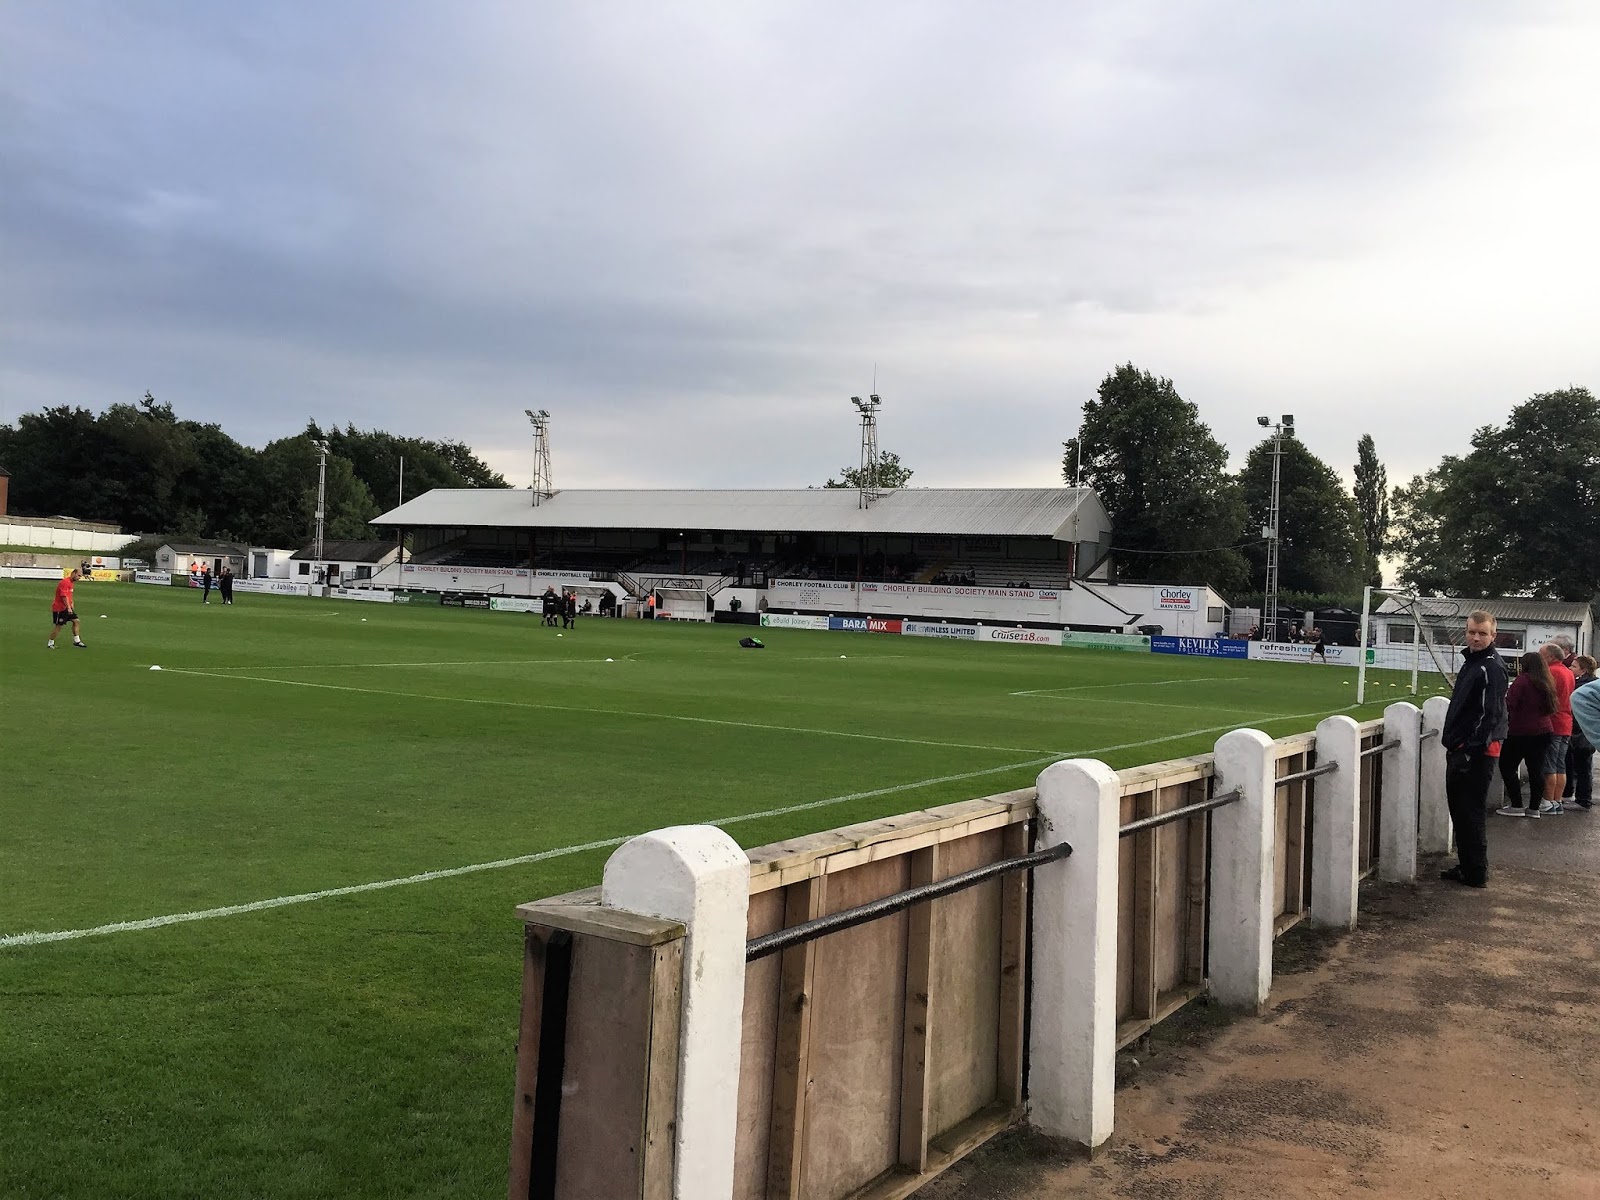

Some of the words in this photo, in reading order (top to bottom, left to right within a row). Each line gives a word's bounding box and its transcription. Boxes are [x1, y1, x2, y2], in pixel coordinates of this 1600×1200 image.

[882, 584, 916, 593] CHORLEY
[918, 586, 952, 594] BUILDING
[954, 588, 986, 596] SOCIETY
[1009, 590, 1034, 598] STAND
[1160, 589, 1191, 600] Chorley
[791, 617, 810, 626] Joinery
[842, 620, 867, 629] BARA
[869, 621, 888, 630] MIX
[991, 629, 1050, 642] Cruise118.com
[1179, 638, 1219, 650] KEVILLS
[1260, 644, 1343, 655] refreshrecery
